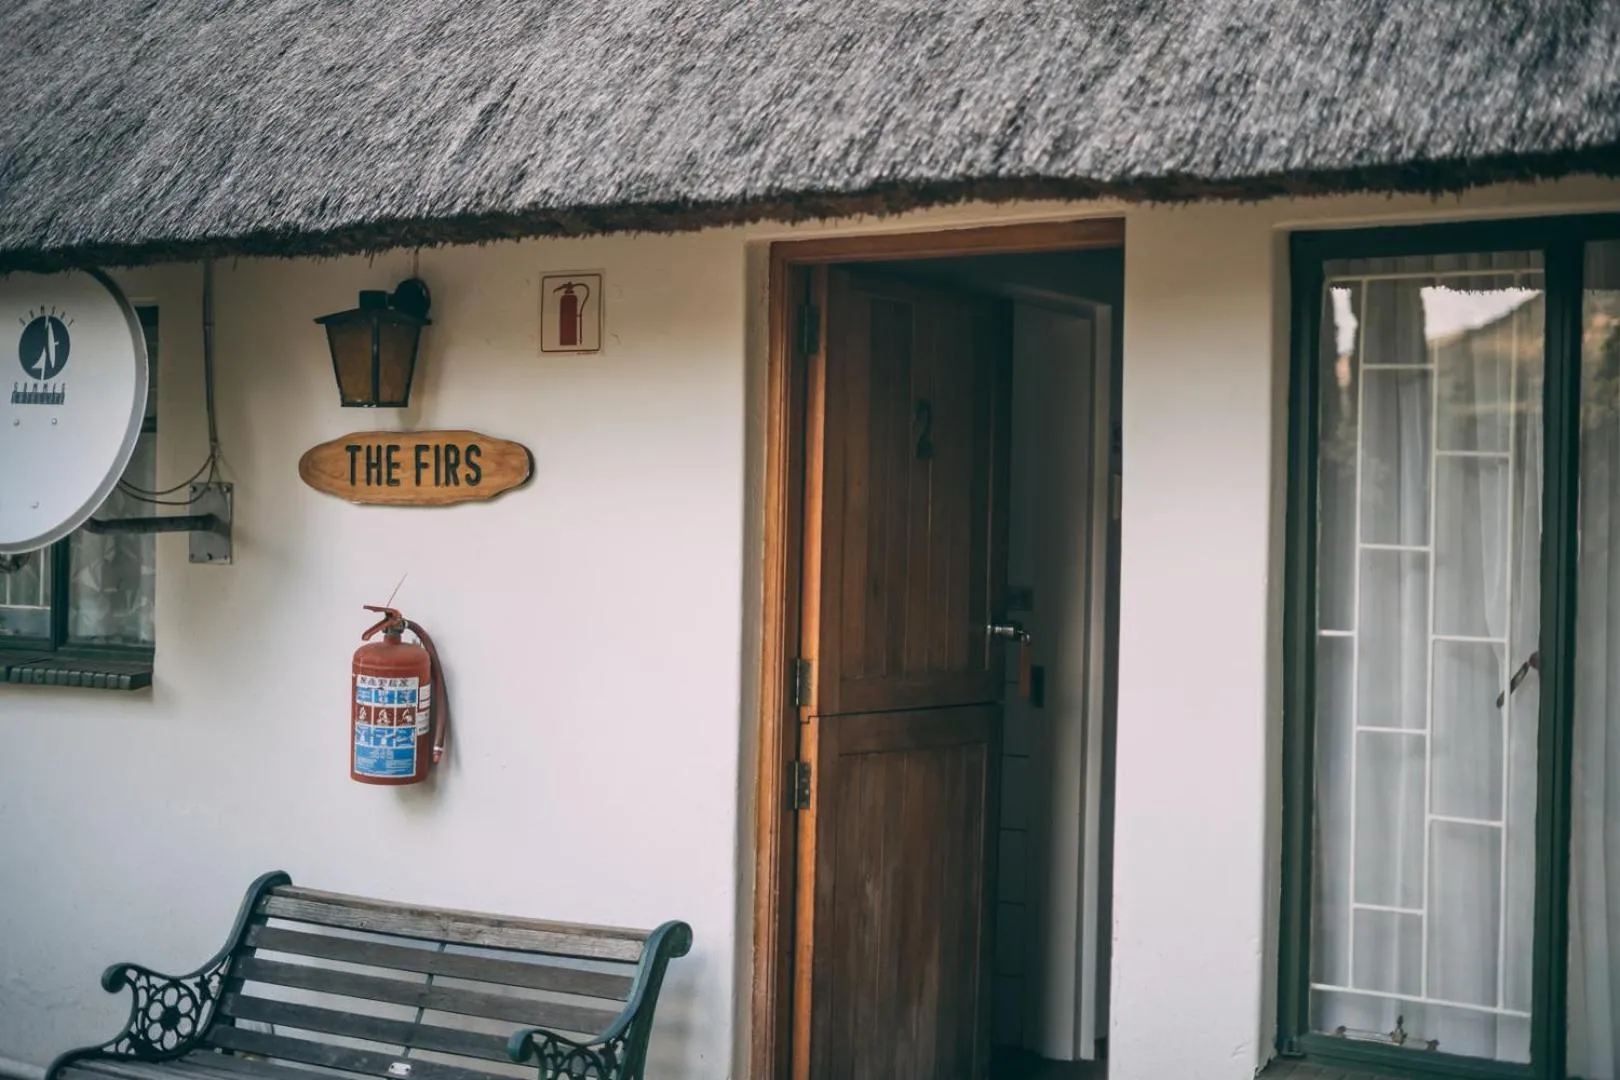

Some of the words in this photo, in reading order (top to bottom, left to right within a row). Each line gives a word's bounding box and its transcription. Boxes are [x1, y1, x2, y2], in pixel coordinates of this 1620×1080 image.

[914, 397, 932, 459] 2
[345, 444, 401, 487] THE
[414, 443, 482, 487] FIRS
